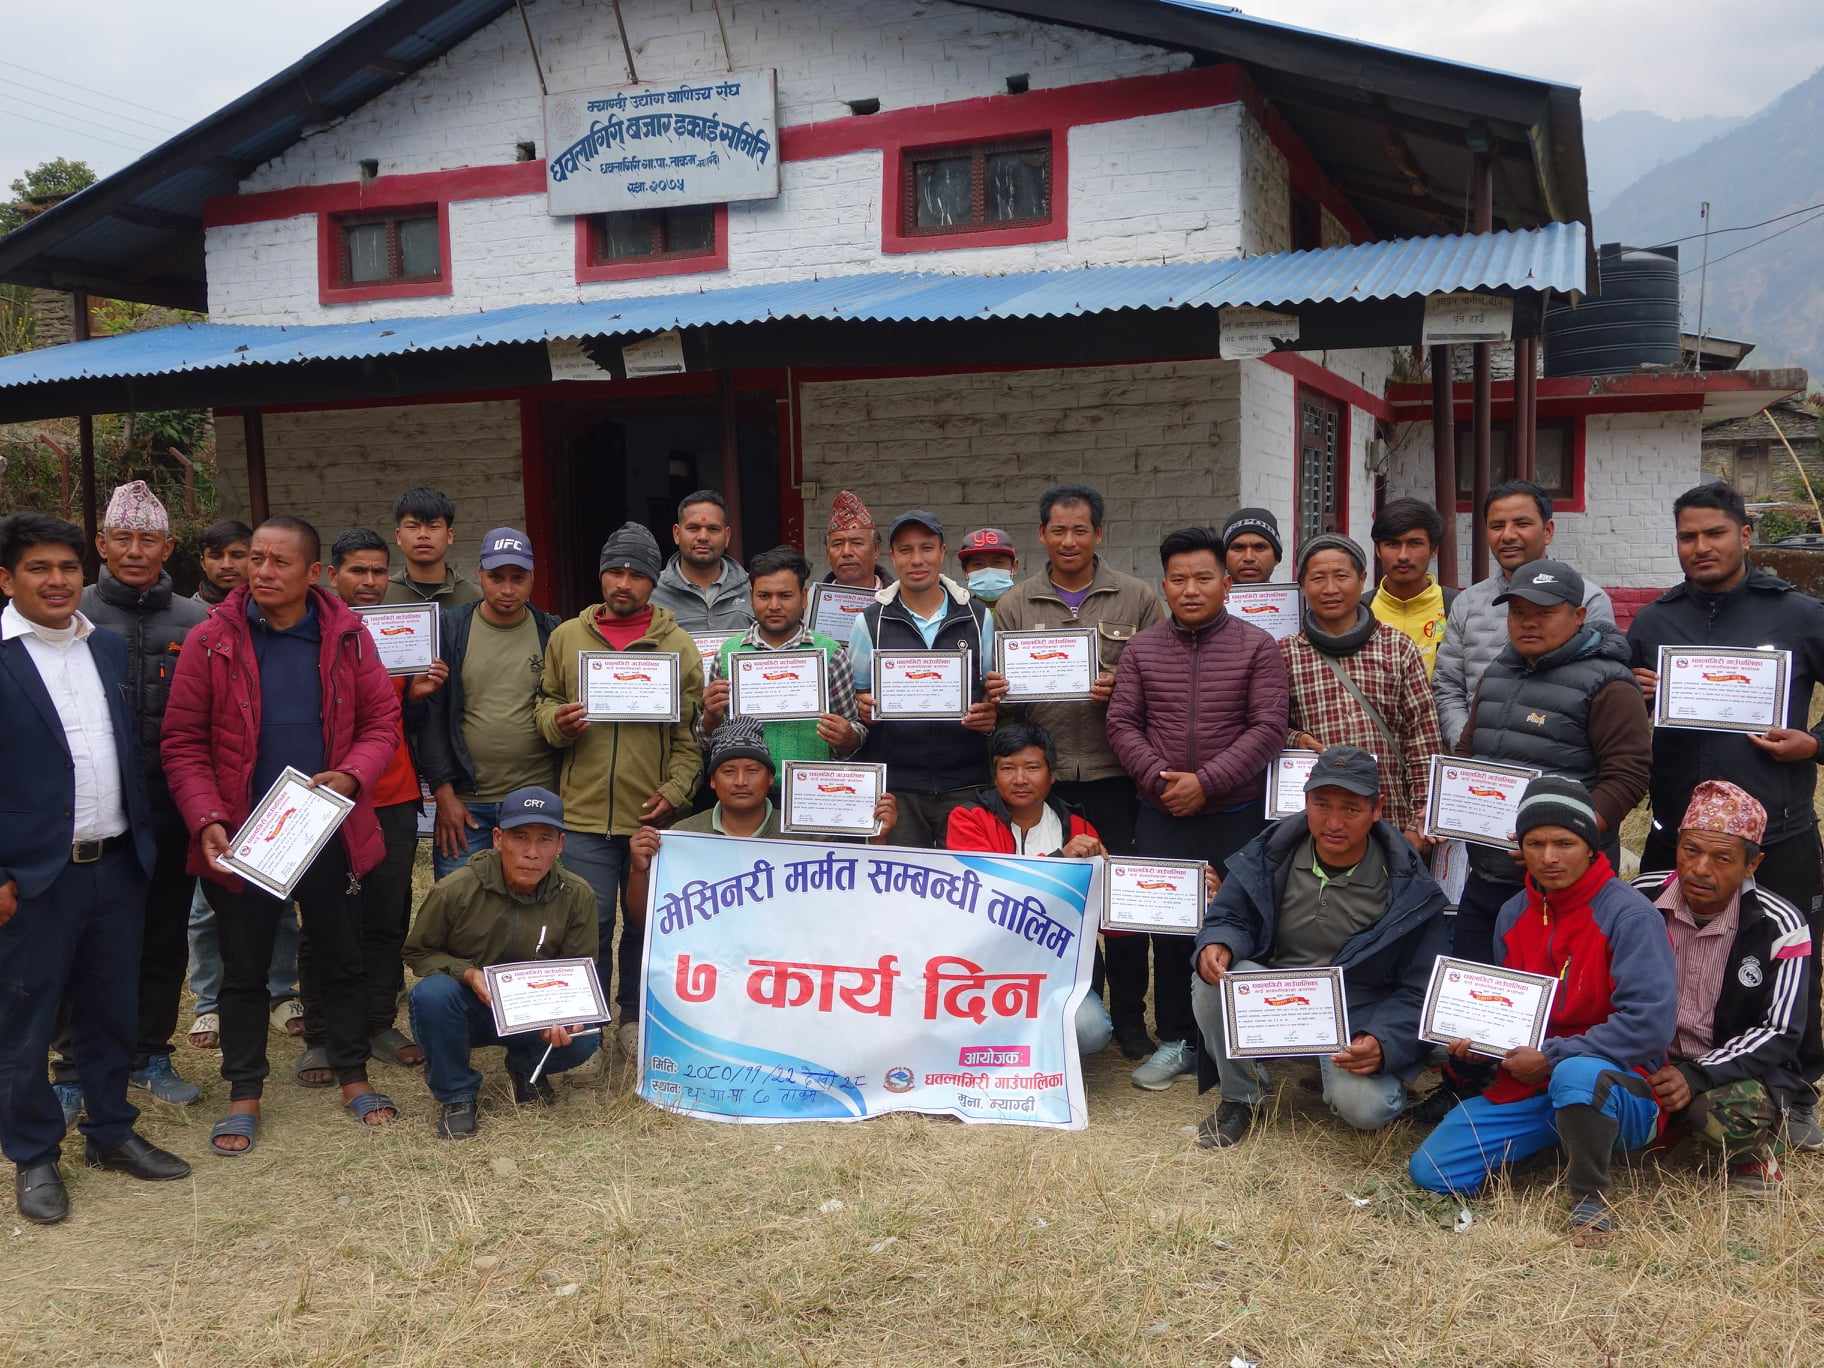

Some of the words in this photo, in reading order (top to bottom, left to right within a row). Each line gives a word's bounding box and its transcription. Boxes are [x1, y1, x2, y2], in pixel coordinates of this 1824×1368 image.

[493, 538, 523, 551] UFC
[523, 799, 545, 809] CR7
[656, 859, 776, 936] मेसिनरी
[784, 851, 858, 894] मर्मत
[868, 858, 981, 915] सम्बन्धी
[987, 888, 1075, 959] तालिम
[675, 954, 717, 1003] ७
[746, 954, 900, 1017] कार्य
[923, 955, 1047, 1024] दिन
[924, 1072, 989, 1090] धवलागिरी
[994, 1072, 1063, 1090] गाउँपालिका
